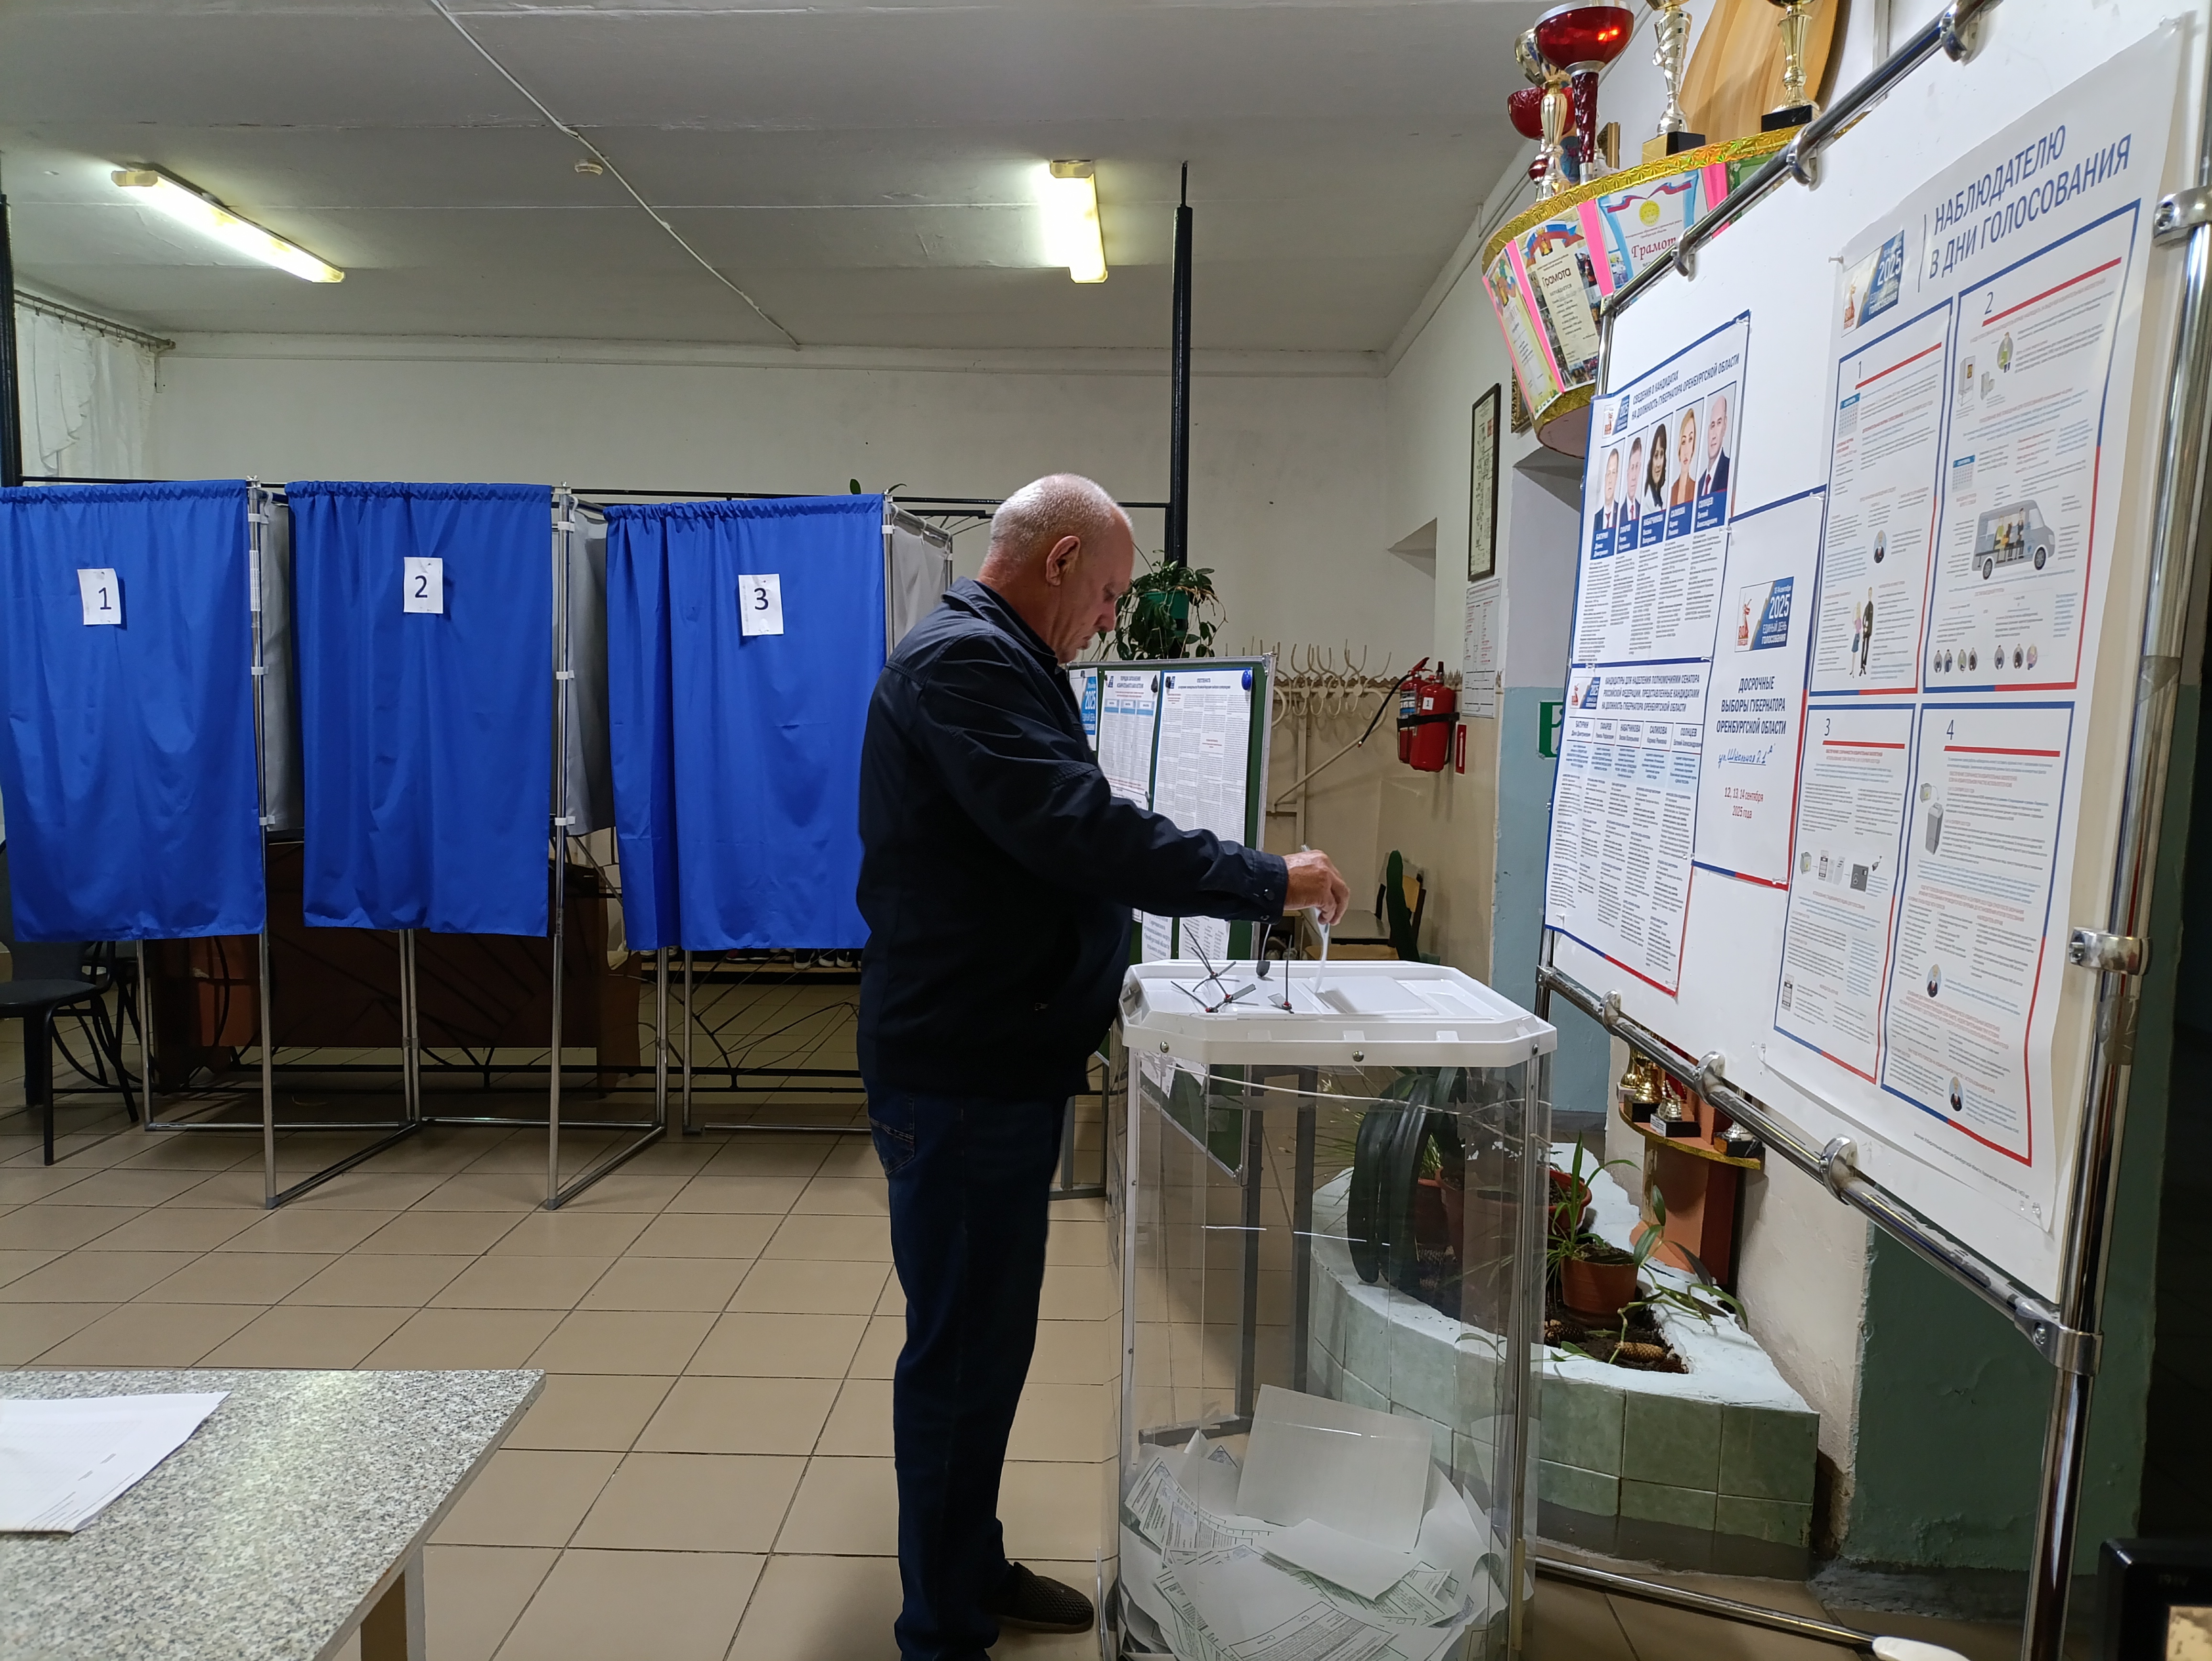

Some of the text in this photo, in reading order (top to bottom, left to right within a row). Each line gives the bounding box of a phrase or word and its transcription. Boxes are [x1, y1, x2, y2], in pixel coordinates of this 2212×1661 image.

[1934, 125, 2066, 236] НАБЛЮДАТЕЛЮ
[1929, 133, 2133, 280] В ДНИ ГОЛОСОВАНИЯ
[1631, 237, 1676, 261] Грамот
[1541, 267, 1571, 289] Грамота
[1877, 249, 1902, 287] 2025
[1984, 291, 1993, 315] 2
[1858, 361, 1861, 378] 1
[1631, 353, 1739, 421] НА ДОЛЖНОСТЬ ГУБЕРНАТОРА ОРЕНБУРГСКОЙ ОБЛАСТИ
[1633, 369, 1679, 405] СВЕДЕНИЯ О КАНДИДАТАХ
[415, 575, 428, 598] 2
[99, 587, 112, 610] 1
[754, 587, 769, 610] 3
[1769, 594, 1790, 620] 2025
[1762, 620, 1787, 634] ЕДИНЫЙ ДЕНЬ
[1681, 674, 1700, 684] СЕНАТОРА
[1738, 675, 1775, 694] ДОСРОЧНЫЕ
[1084, 690, 1096, 710] 2025
[1670, 703, 1687, 712] ОБЛАСТИ
[1721, 698, 1785, 712] ВЫБОРЫ ГУБЕРНАТОРА
[1716, 718, 1787, 734] ОРЕНБУРГСКОЙ ОБЛАСТИ
[1824, 718, 1830, 736] 3
[1946, 720, 1954, 740] 4
[1739, 789, 1745, 799] 14
[1745, 790, 1764, 804] сентября
[1732, 805, 1752, 819] 2025 года
